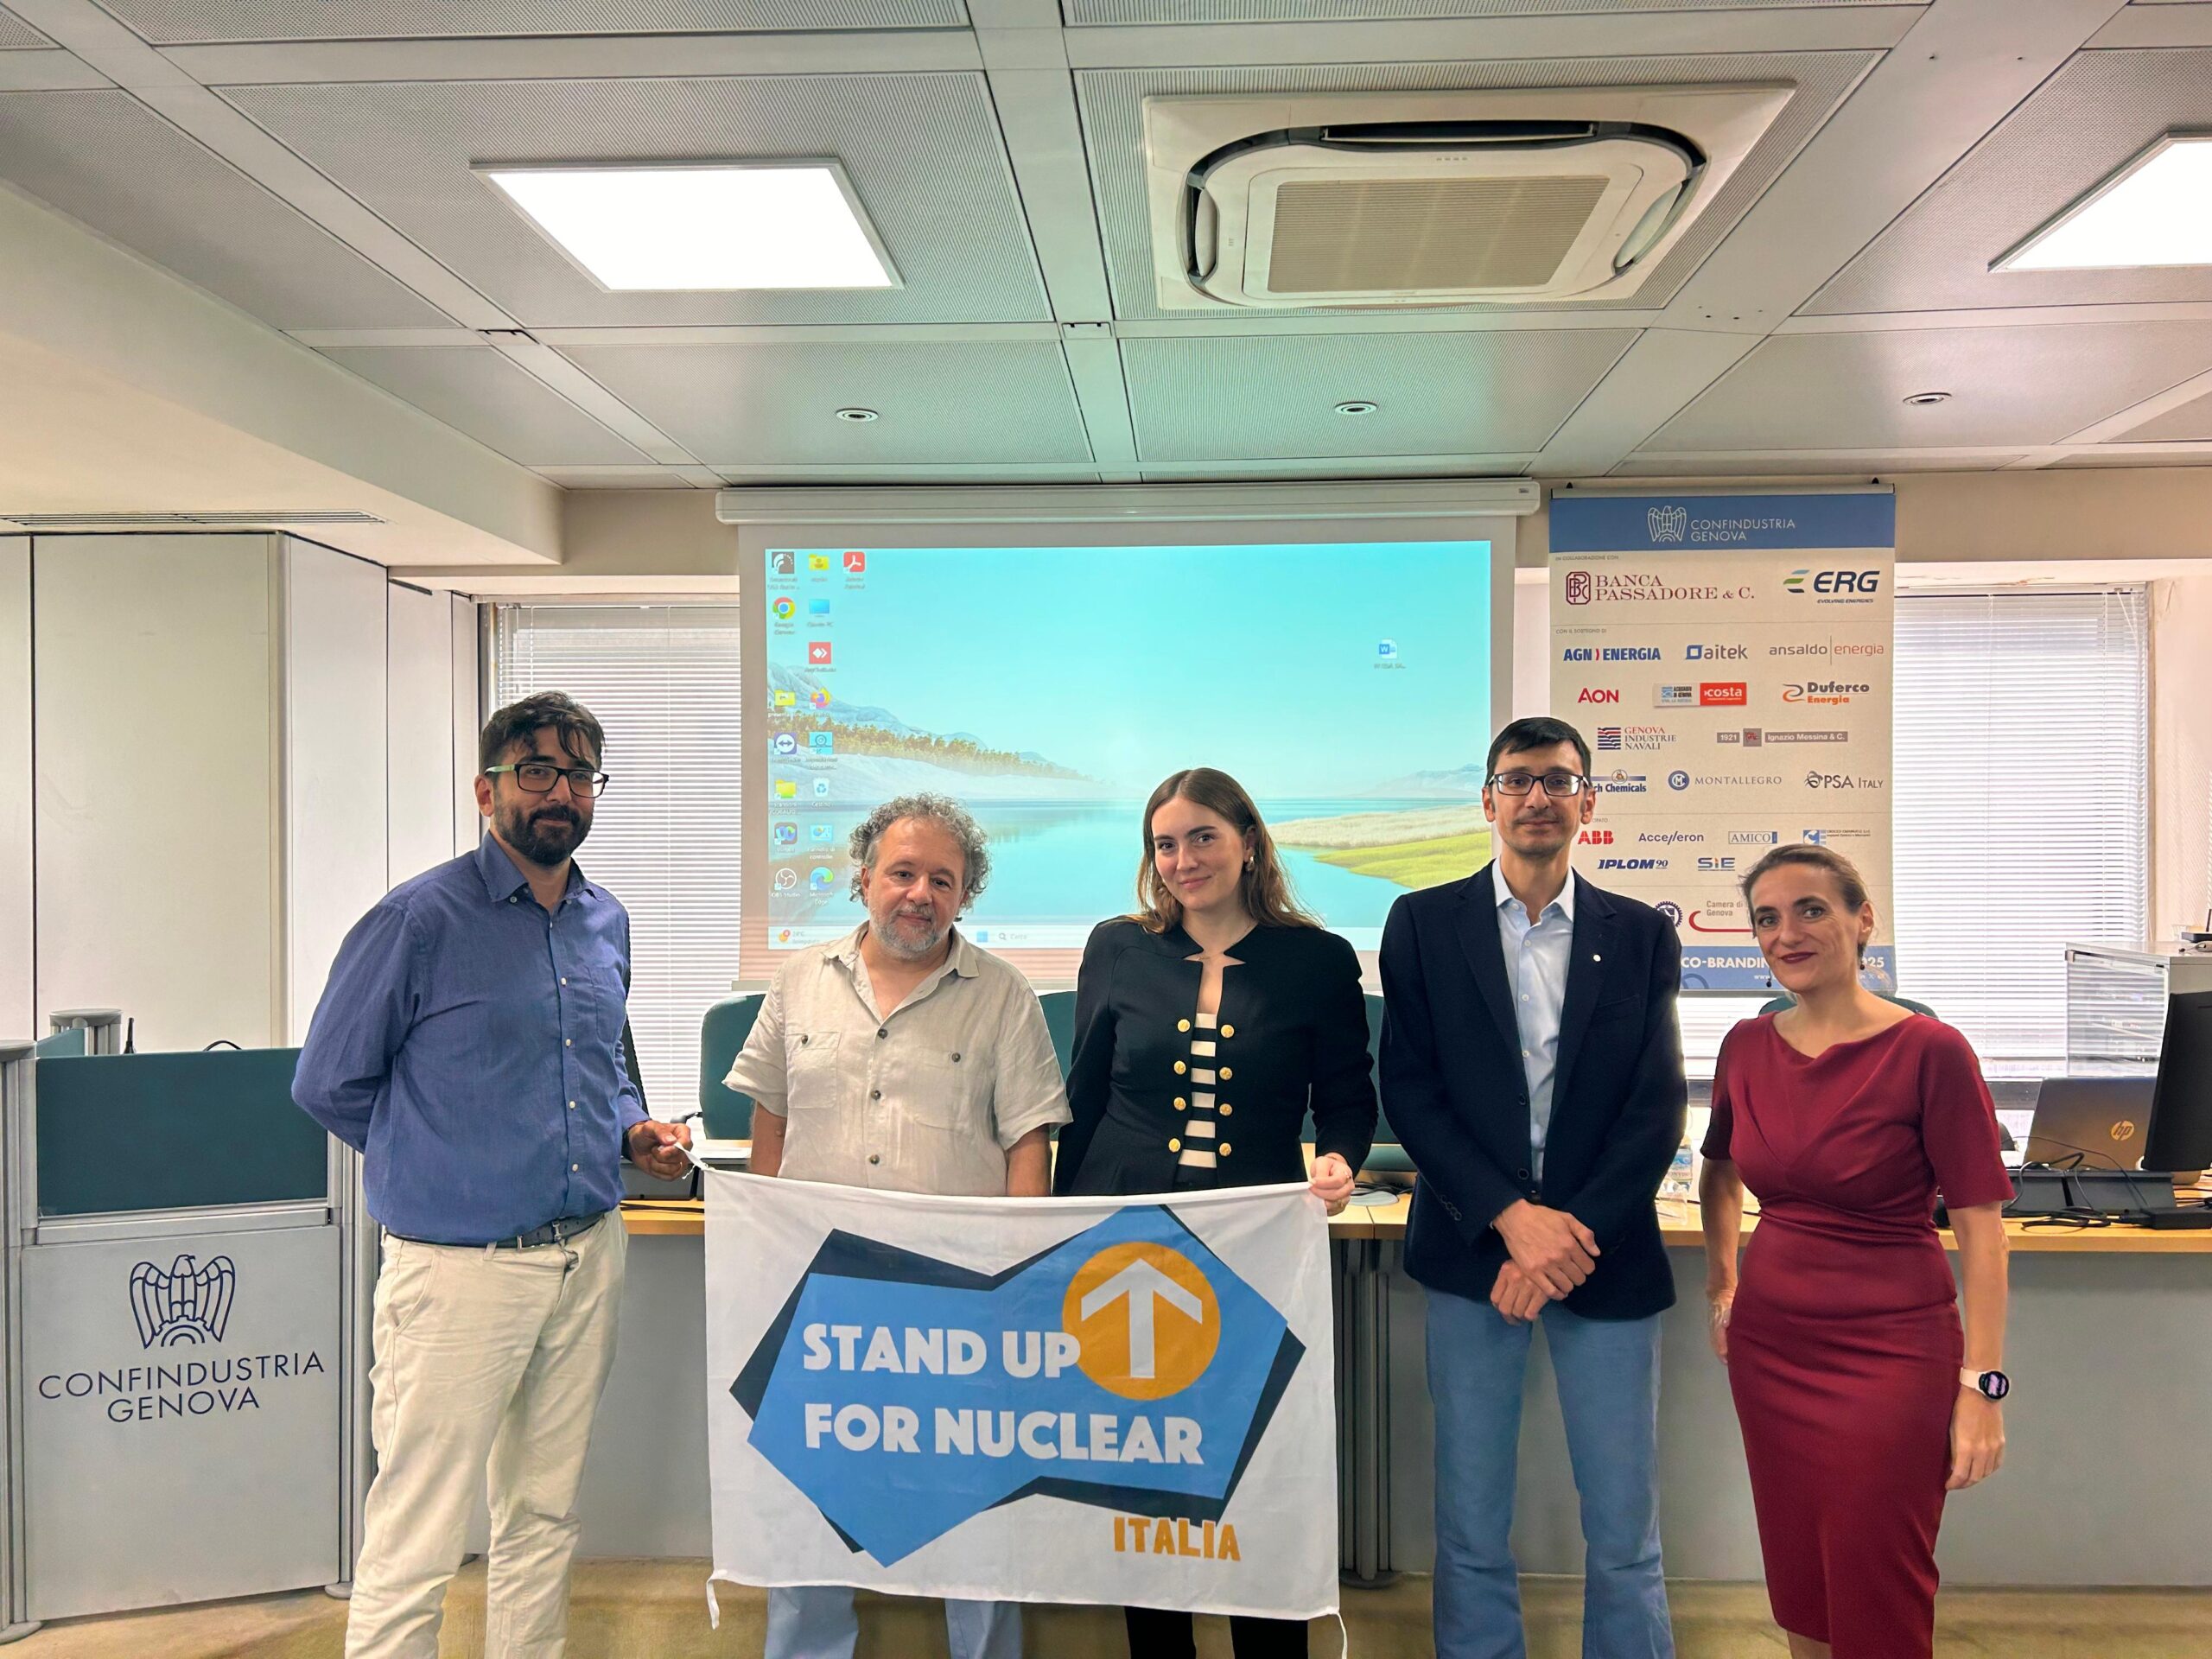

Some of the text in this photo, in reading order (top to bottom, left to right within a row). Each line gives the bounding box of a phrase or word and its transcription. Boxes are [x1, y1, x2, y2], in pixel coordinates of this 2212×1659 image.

[1690, 518, 1796, 531] CONFINDUSTRIA
[1690, 531, 1747, 543] GENOVA
[1595, 574, 1664, 588] BANCA
[1813, 570, 1881, 594] ERG
[1595, 587, 1755, 601] PASSADORE & C.
[1563, 647, 1662, 662] AGN ENERGIA
[1703, 644, 1749, 660] aitek
[1769, 644, 1885, 657] ansaldo energia
[1706, 687, 1743, 697] costa
[1807, 681, 1870, 693] Duferco
[1577, 687, 1619, 704] AON
[1807, 695, 1850, 705] Energia
[1605, 783, 1647, 792] Chemicals
[1694, 776, 1783, 785] MONTALLEGRO
[1824, 774, 1854, 789] PSA
[1578, 830, 1614, 845] ABB
[1638, 831, 1704, 845] Accelleron
[1731, 832, 1771, 842] AMICO
[1597, 859, 1656, 870] IPLOM
[1681, 957, 1770, 969] CO-BRANDIN
[2112, 1120, 2133, 1141] hp
[802, 1323, 1081, 1378] STAND UP
[39, 1351, 324, 1399] CONFINDUSTRIA
[107, 1386, 260, 1422] GENOVA
[804, 1403, 1205, 1465] FOR NUCLEAR
[1113, 1516, 1241, 1561] ITALIA
